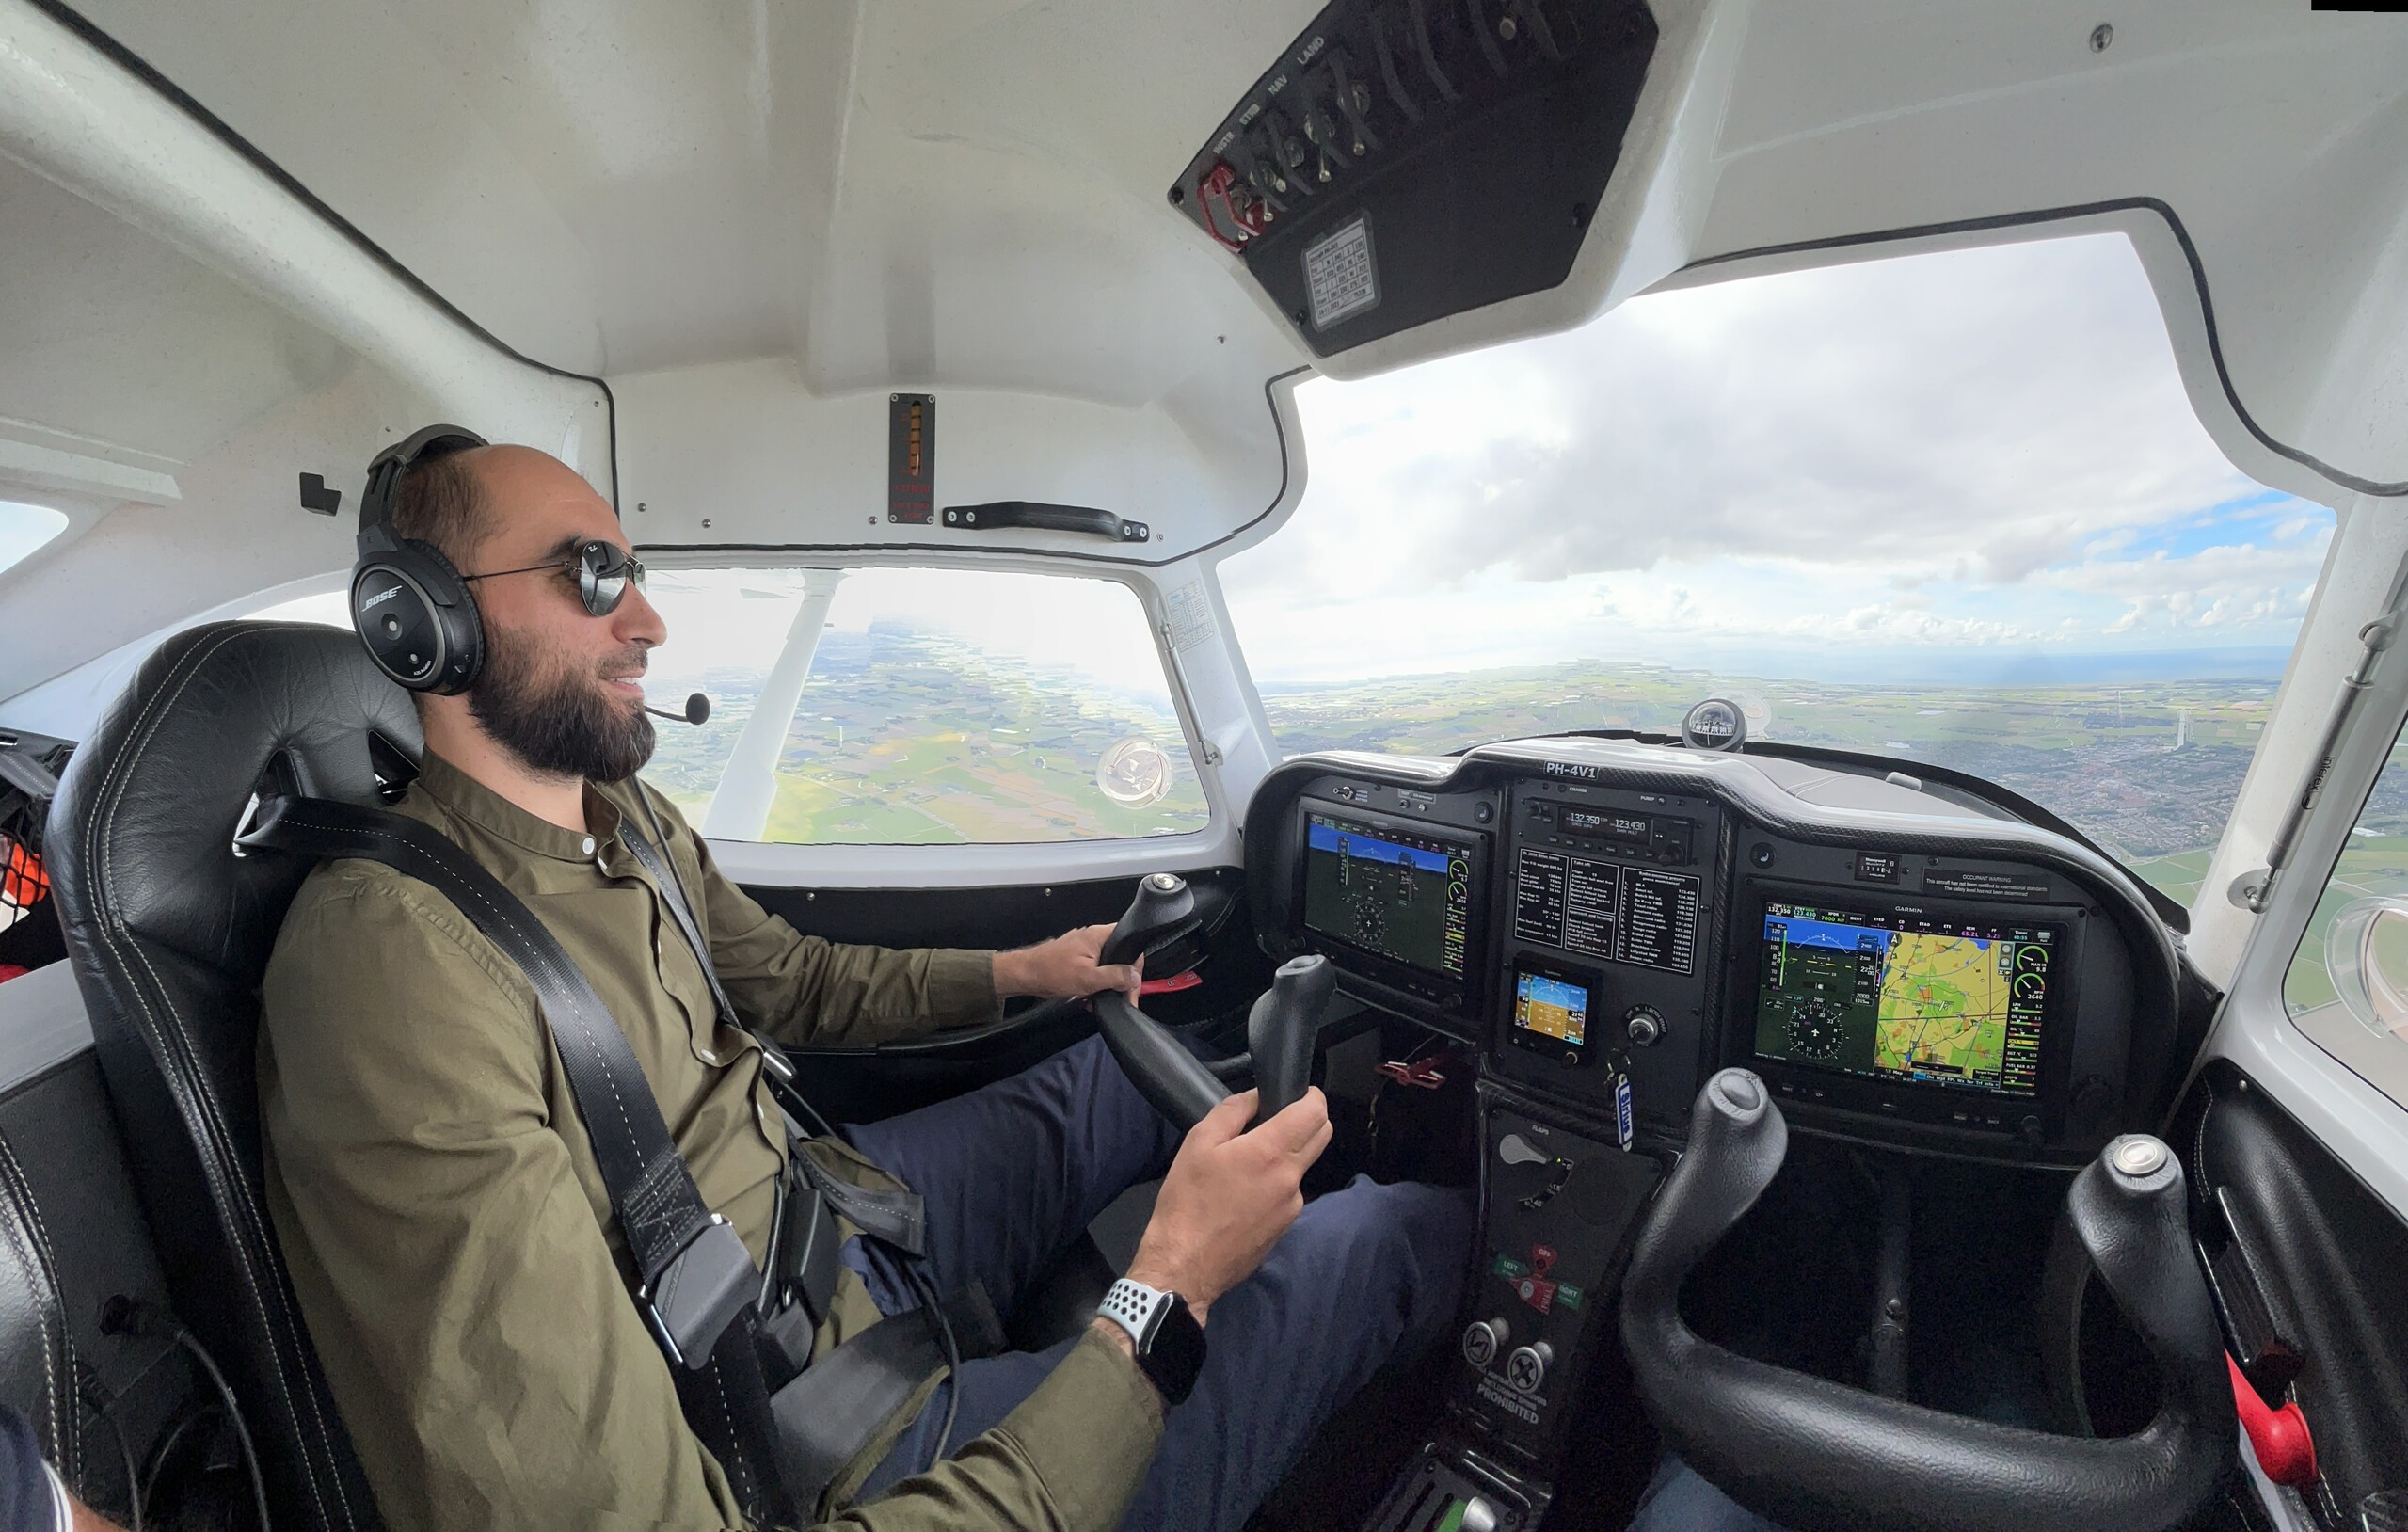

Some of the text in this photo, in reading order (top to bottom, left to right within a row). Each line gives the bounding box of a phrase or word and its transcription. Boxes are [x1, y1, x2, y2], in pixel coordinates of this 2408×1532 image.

[1297, 36, 1325, 64] LAND
[1268, 75, 1287, 95] NAV
[362, 585, 402, 612] BOSE
[1547, 762, 1596, 778] PH-4V1
[1571, 813, 1599, 824] 132.350
[1615, 819, 1645, 831] 123.430
[1621, 1092, 1631, 1134] Sirius
[1532, 1125, 1549, 1135] FLAPS
[1539, 1248, 1552, 1257] OFF
[1504, 1260, 1518, 1271] LEFT
[1477, 1383, 1539, 1425] PROHIBITED
